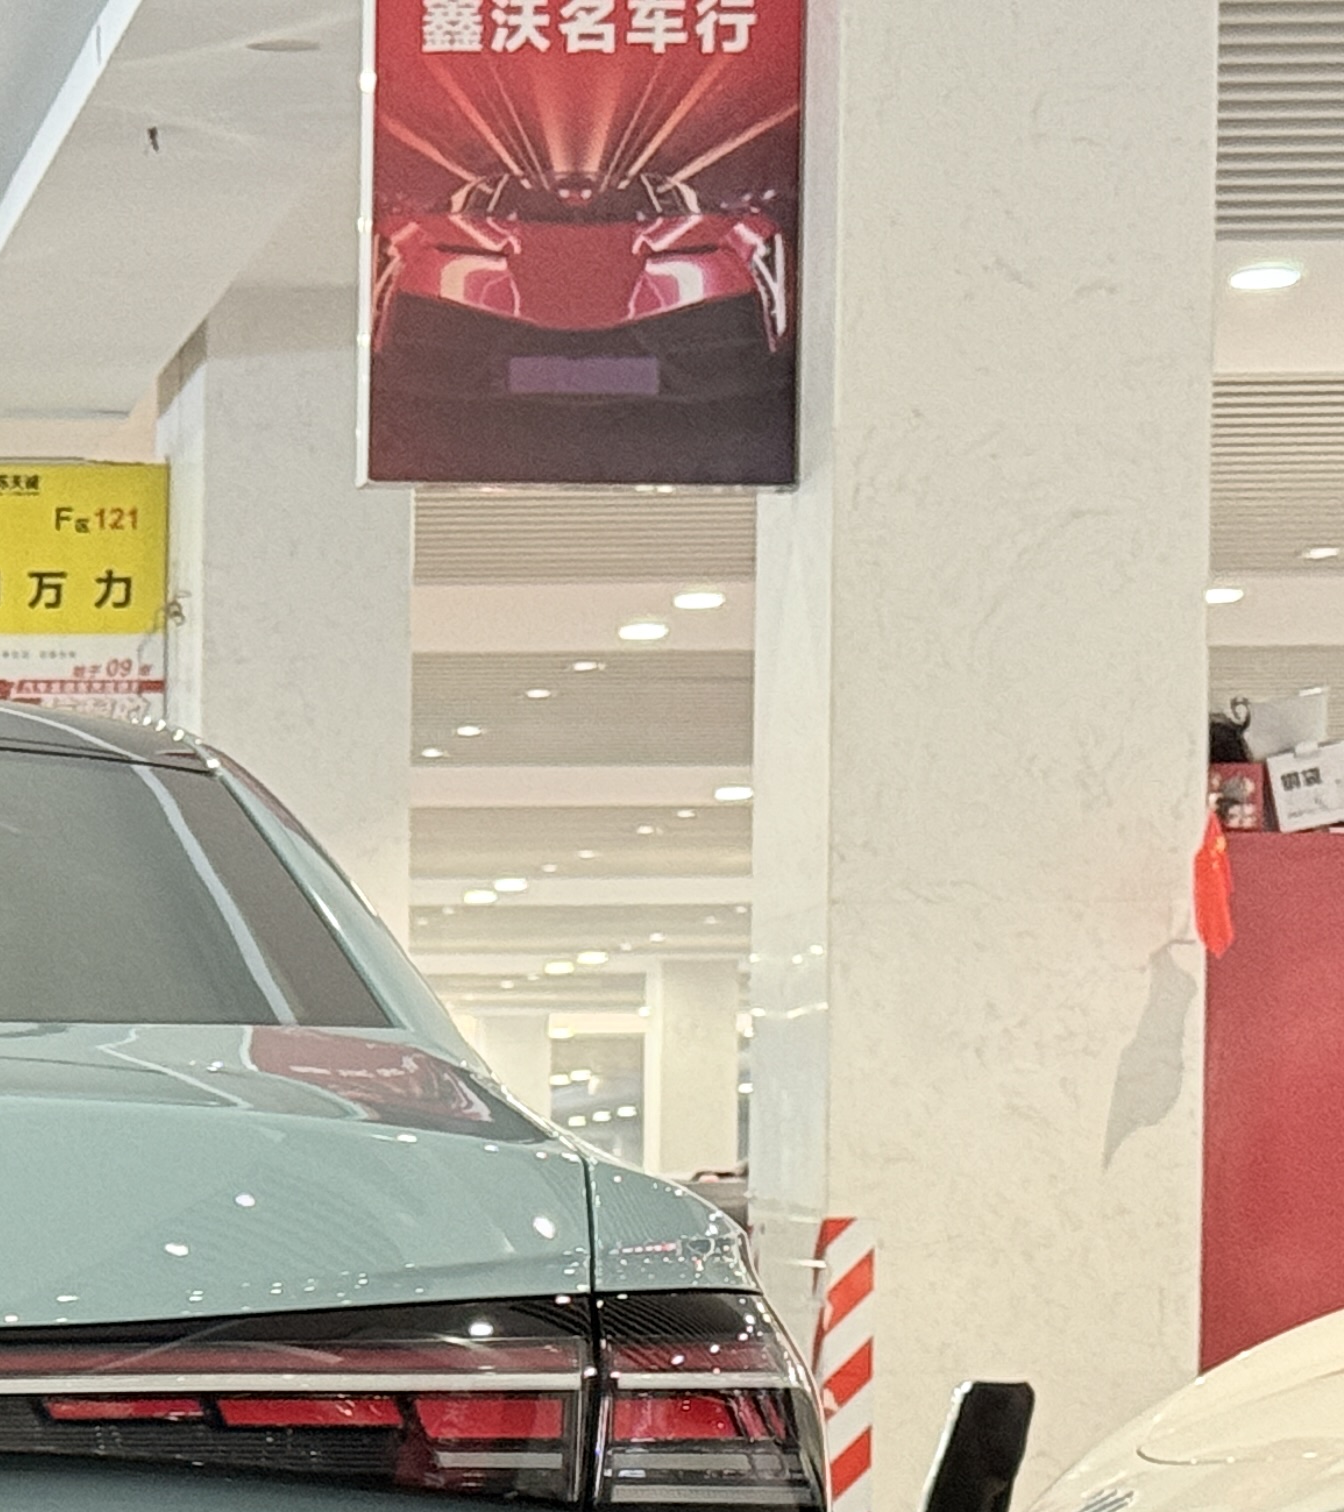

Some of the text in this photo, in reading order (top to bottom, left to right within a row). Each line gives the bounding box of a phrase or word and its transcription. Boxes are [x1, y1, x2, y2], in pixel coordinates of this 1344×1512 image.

[422, 0, 758, 54] 鑫沃名车行
